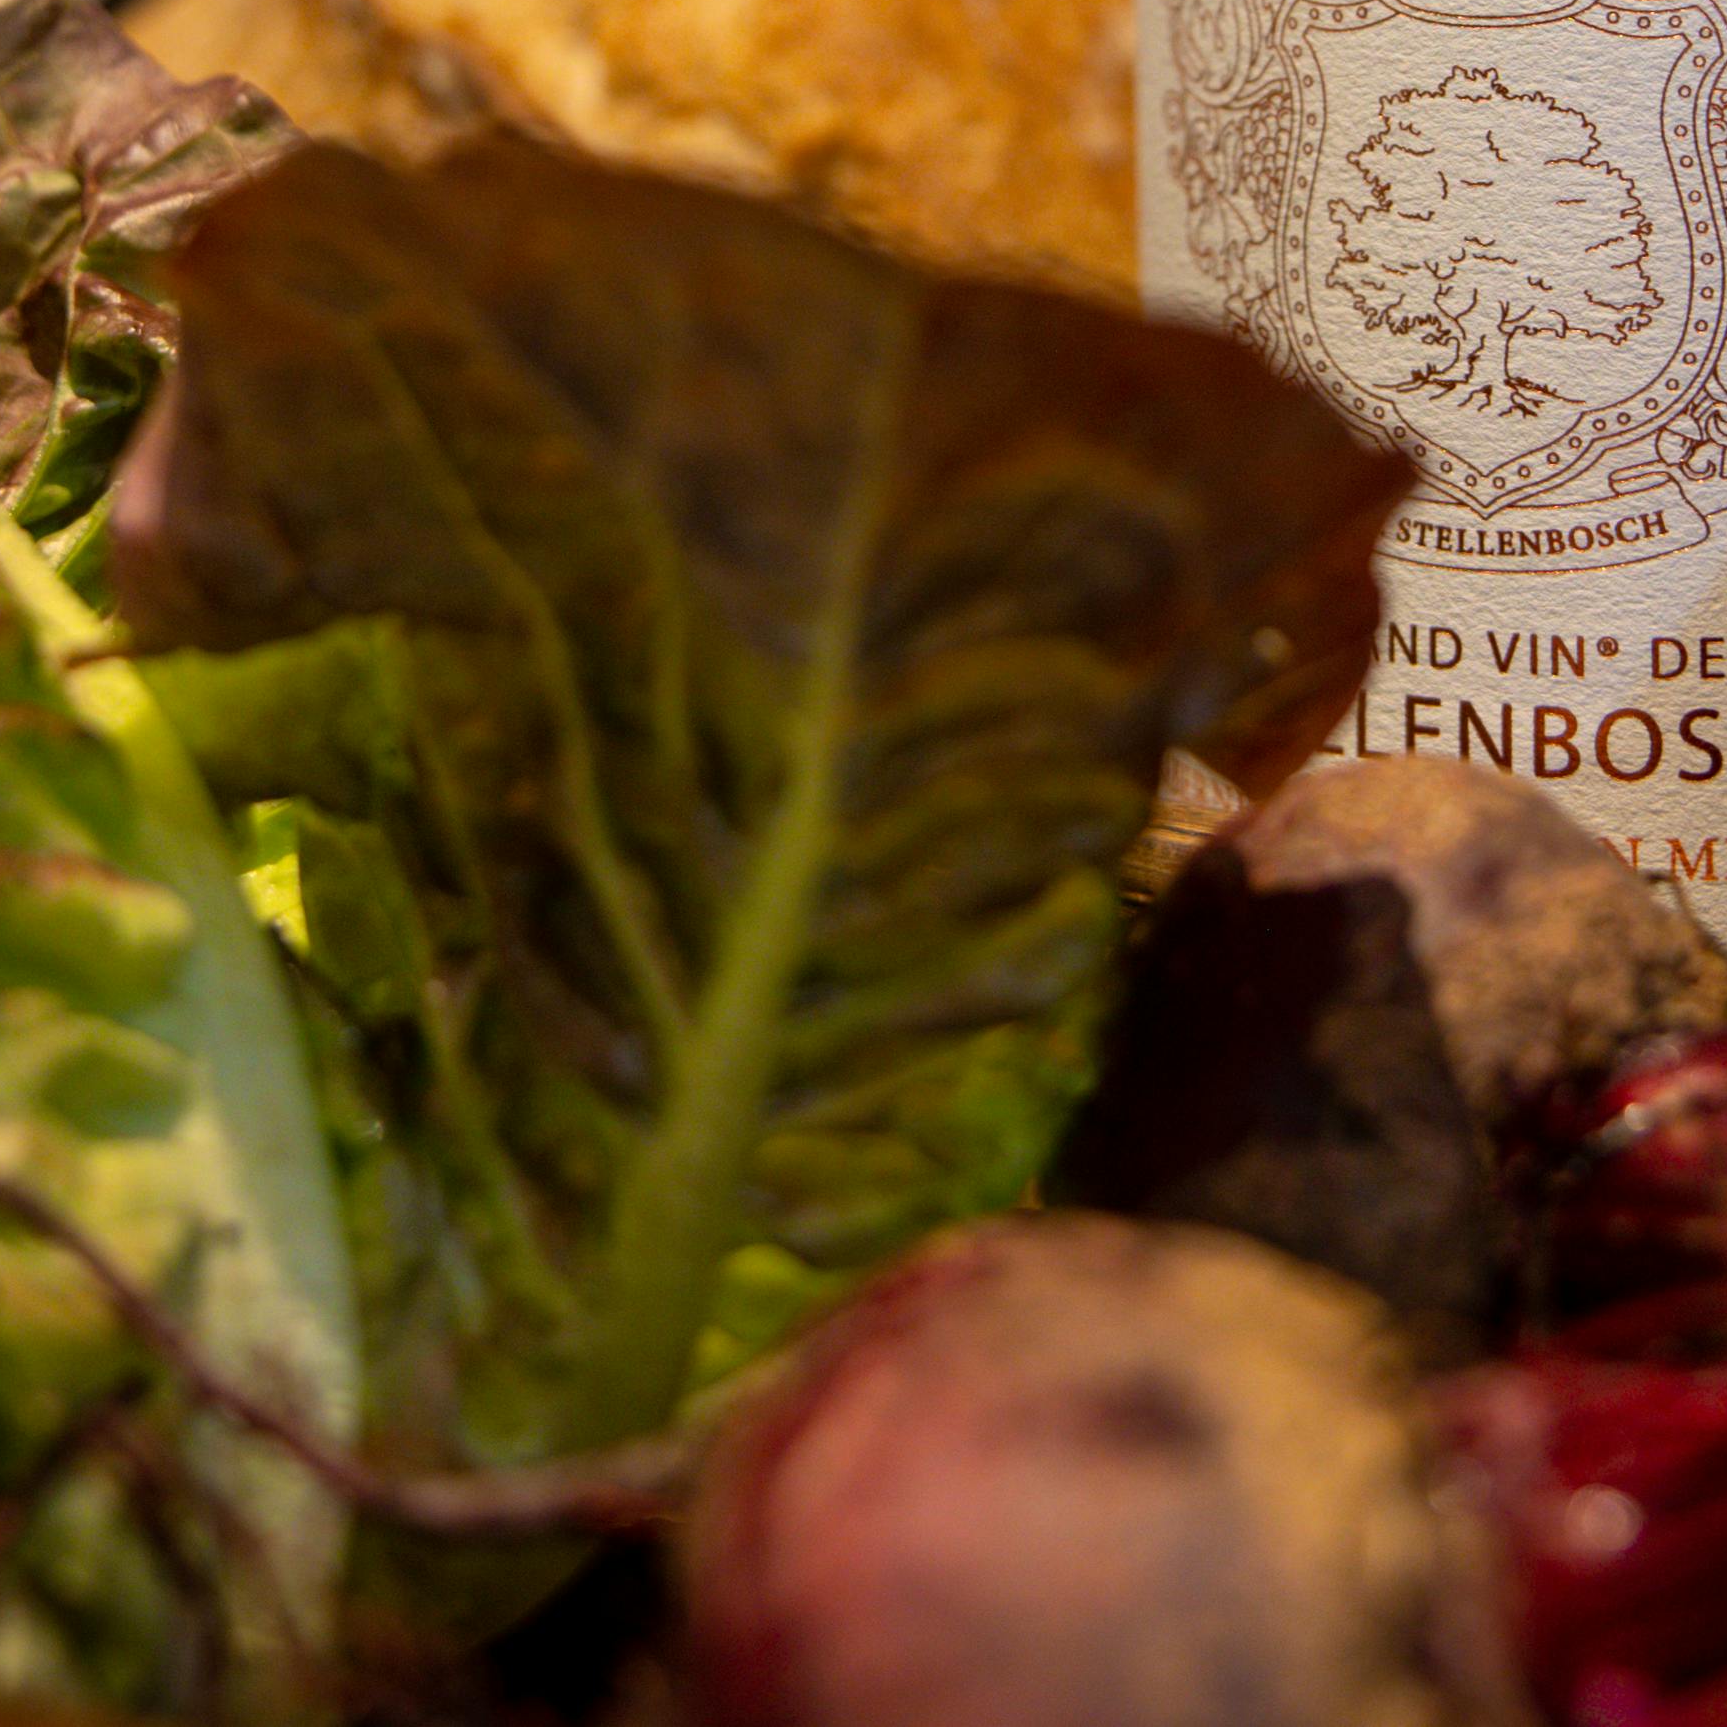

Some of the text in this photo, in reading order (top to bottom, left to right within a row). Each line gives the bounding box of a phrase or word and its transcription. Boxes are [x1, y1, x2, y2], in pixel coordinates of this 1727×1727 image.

[1395, 510, 1670, 557] STELLENBOSCH
[1373, 622, 1463, 670] ND
[1651, 636, 1726, 680] DE
